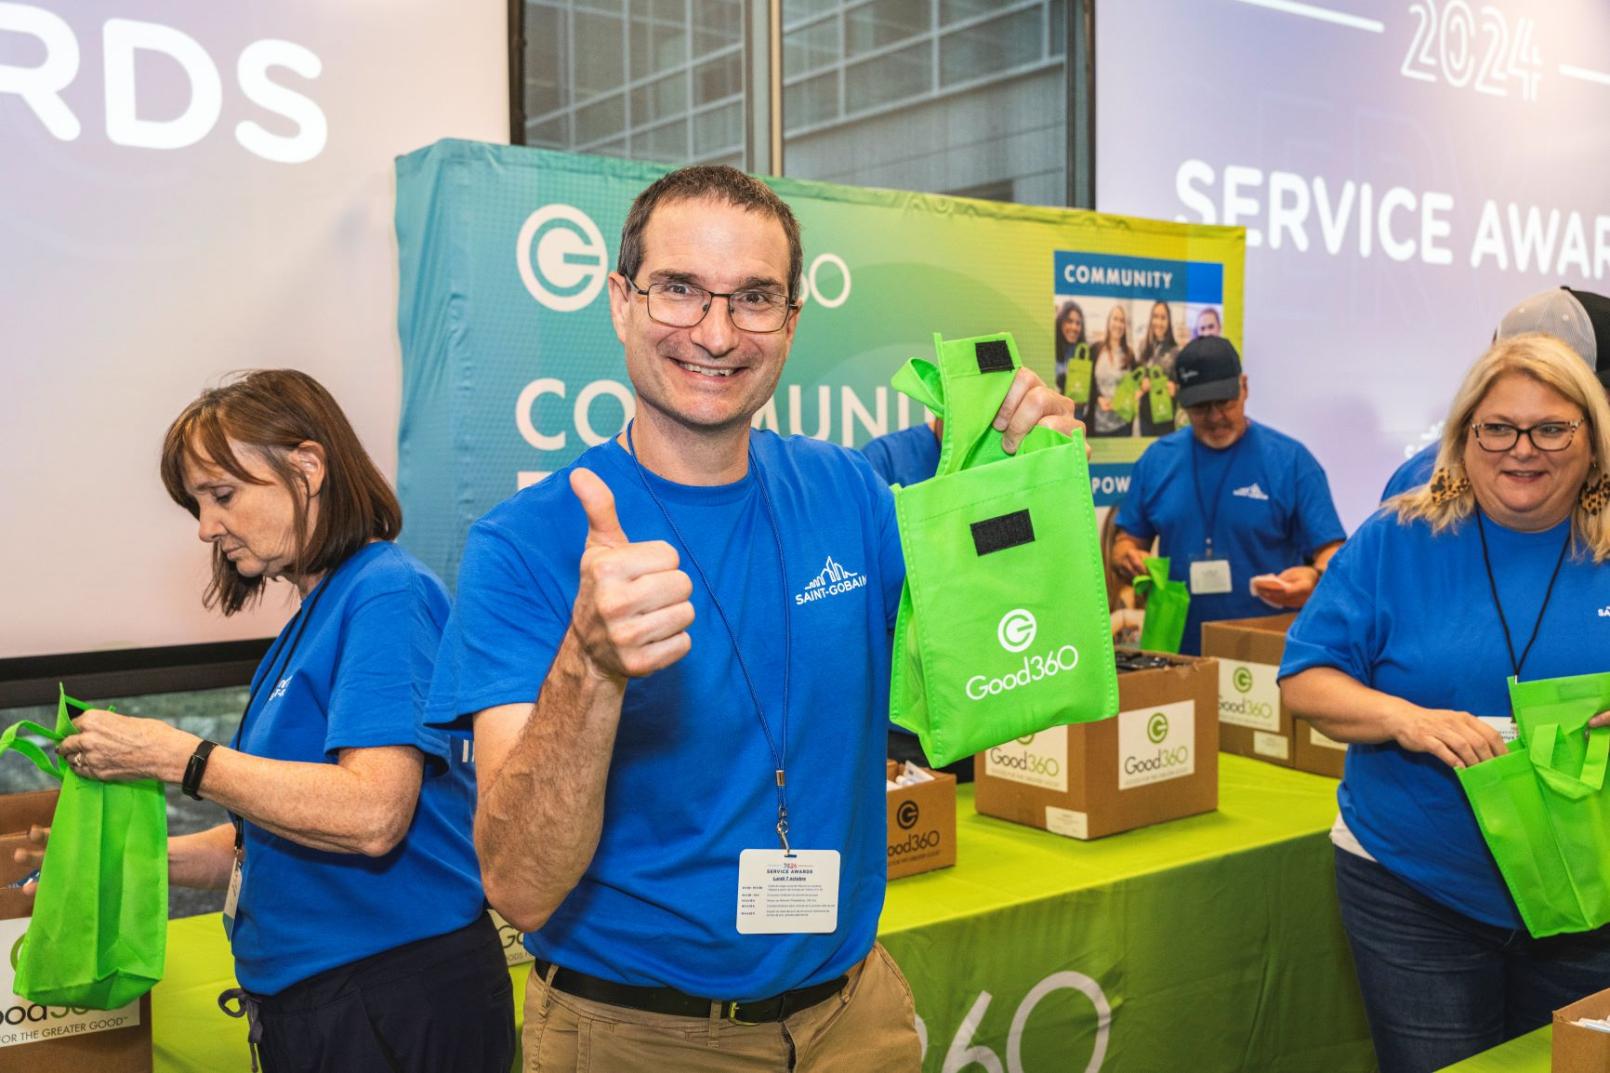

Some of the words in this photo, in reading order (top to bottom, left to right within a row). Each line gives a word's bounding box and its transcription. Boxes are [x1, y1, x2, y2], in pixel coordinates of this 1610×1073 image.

[1401, 0, 1543, 101] 2024
[1175, 159, 1454, 266] SERVICE
[1064, 264, 1173, 289] COMMUNITY
[965, 645, 1079, 700] Good360
[1219, 696, 1272, 719] ood360
[991, 747, 1059, 777] Good360
[1124, 746, 1188, 775] Good360
[887, 829, 940, 857] ood360
[20, 1030, 39, 1041] THE
[42, 1022, 87, 1038] GREATER
[915, 971, 1111, 1073] 60
